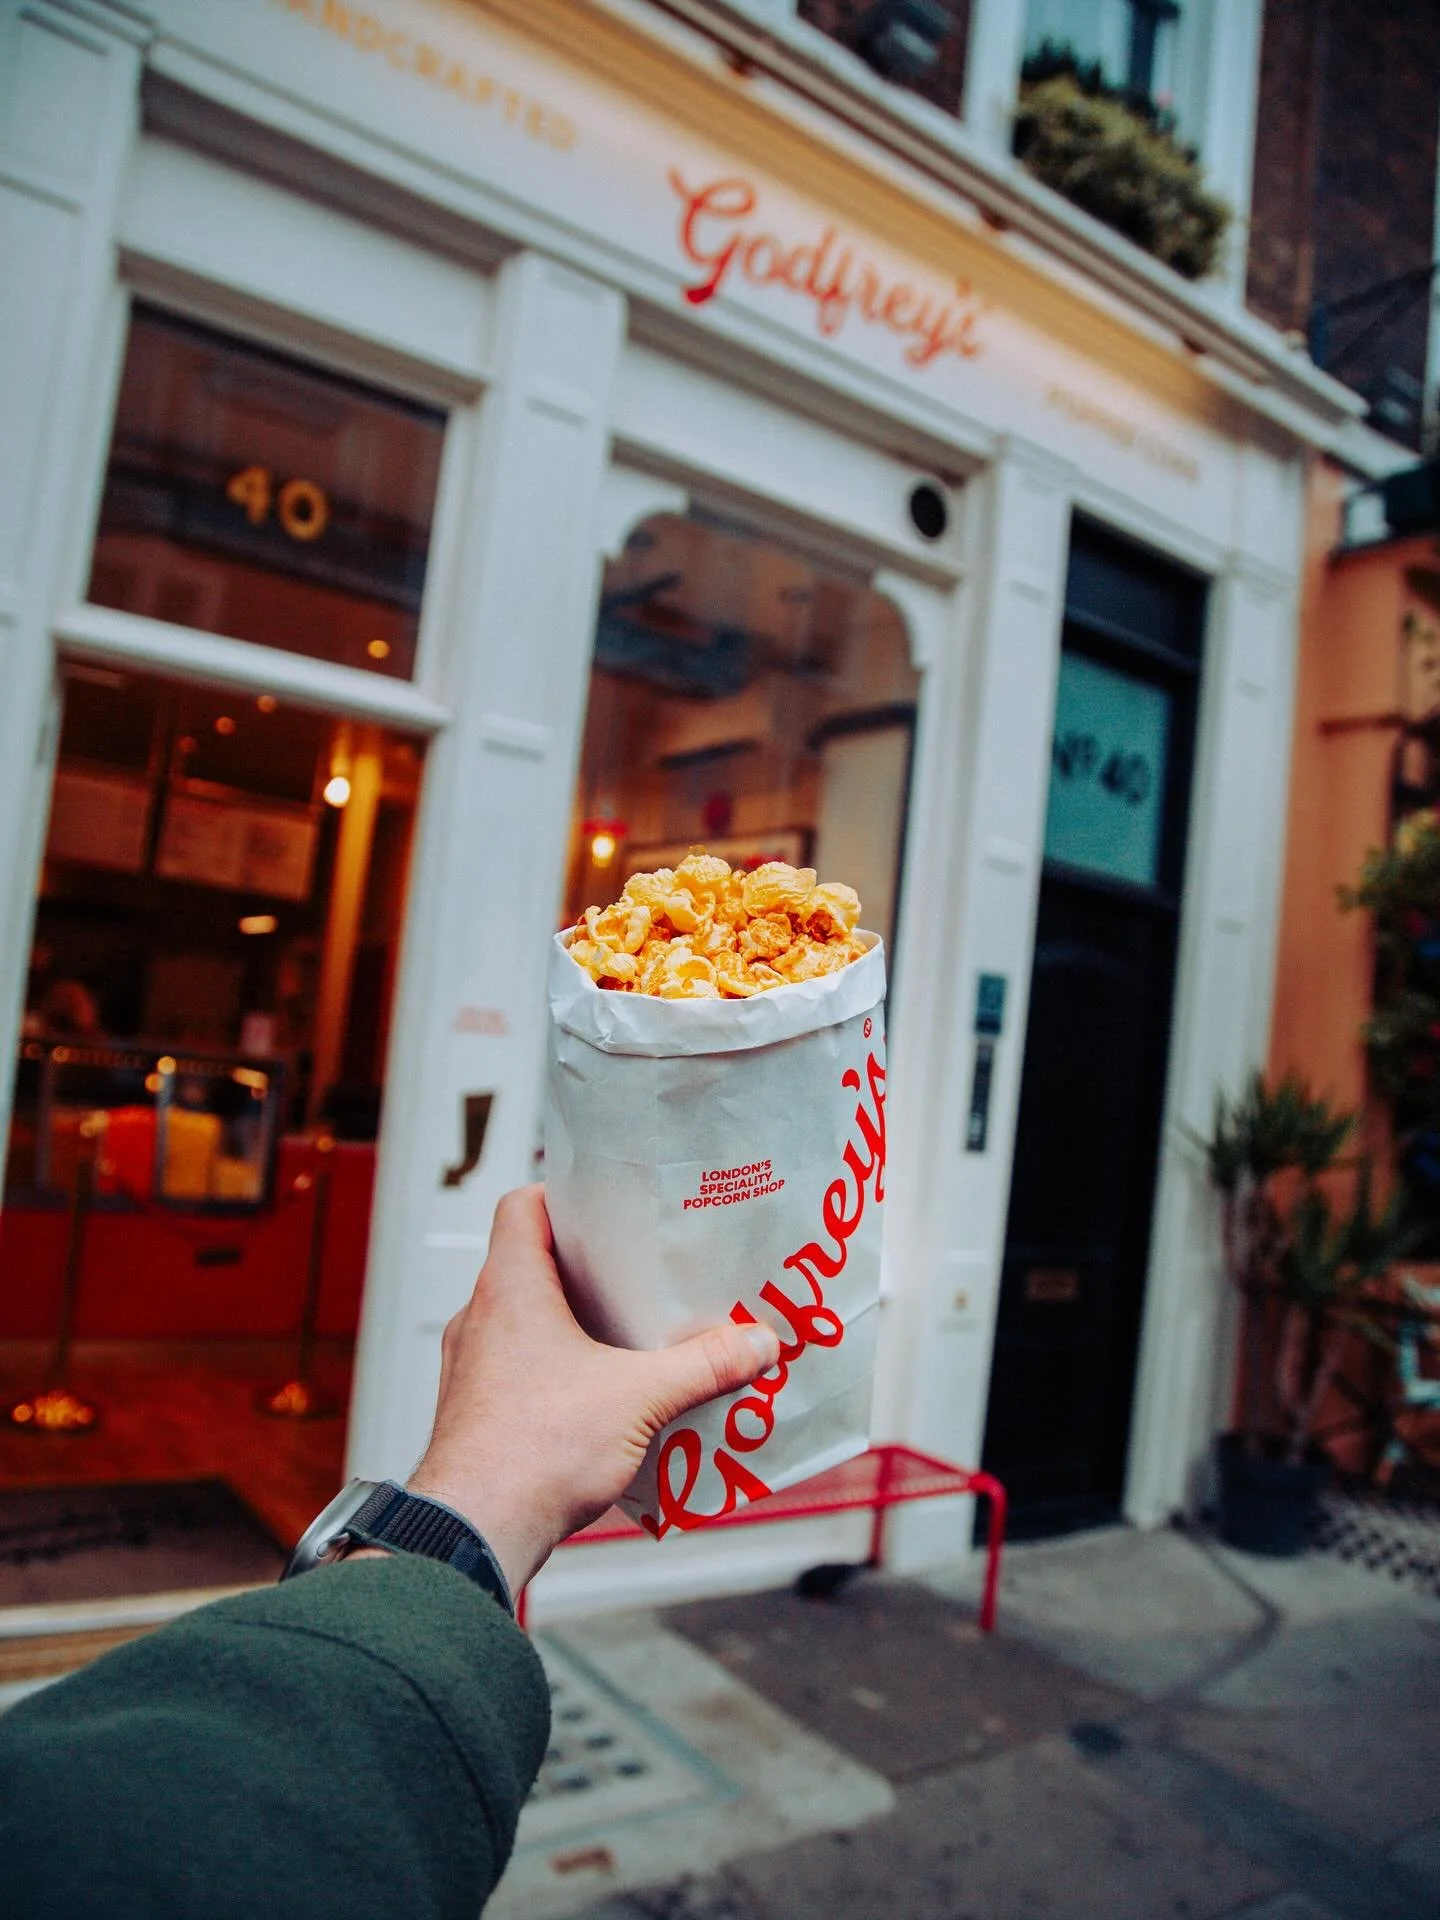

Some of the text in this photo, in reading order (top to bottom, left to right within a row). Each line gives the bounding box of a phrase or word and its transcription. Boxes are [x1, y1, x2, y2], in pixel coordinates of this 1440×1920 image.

[667, 166, 983, 369] Godfrey's
[225, 465, 328, 540] 40
[700, 1171, 773, 1195] SPECIALITY
[702, 1160, 772, 1182] LONDON'S
[683, 1179, 786, 1210] POPCORN SHOP
